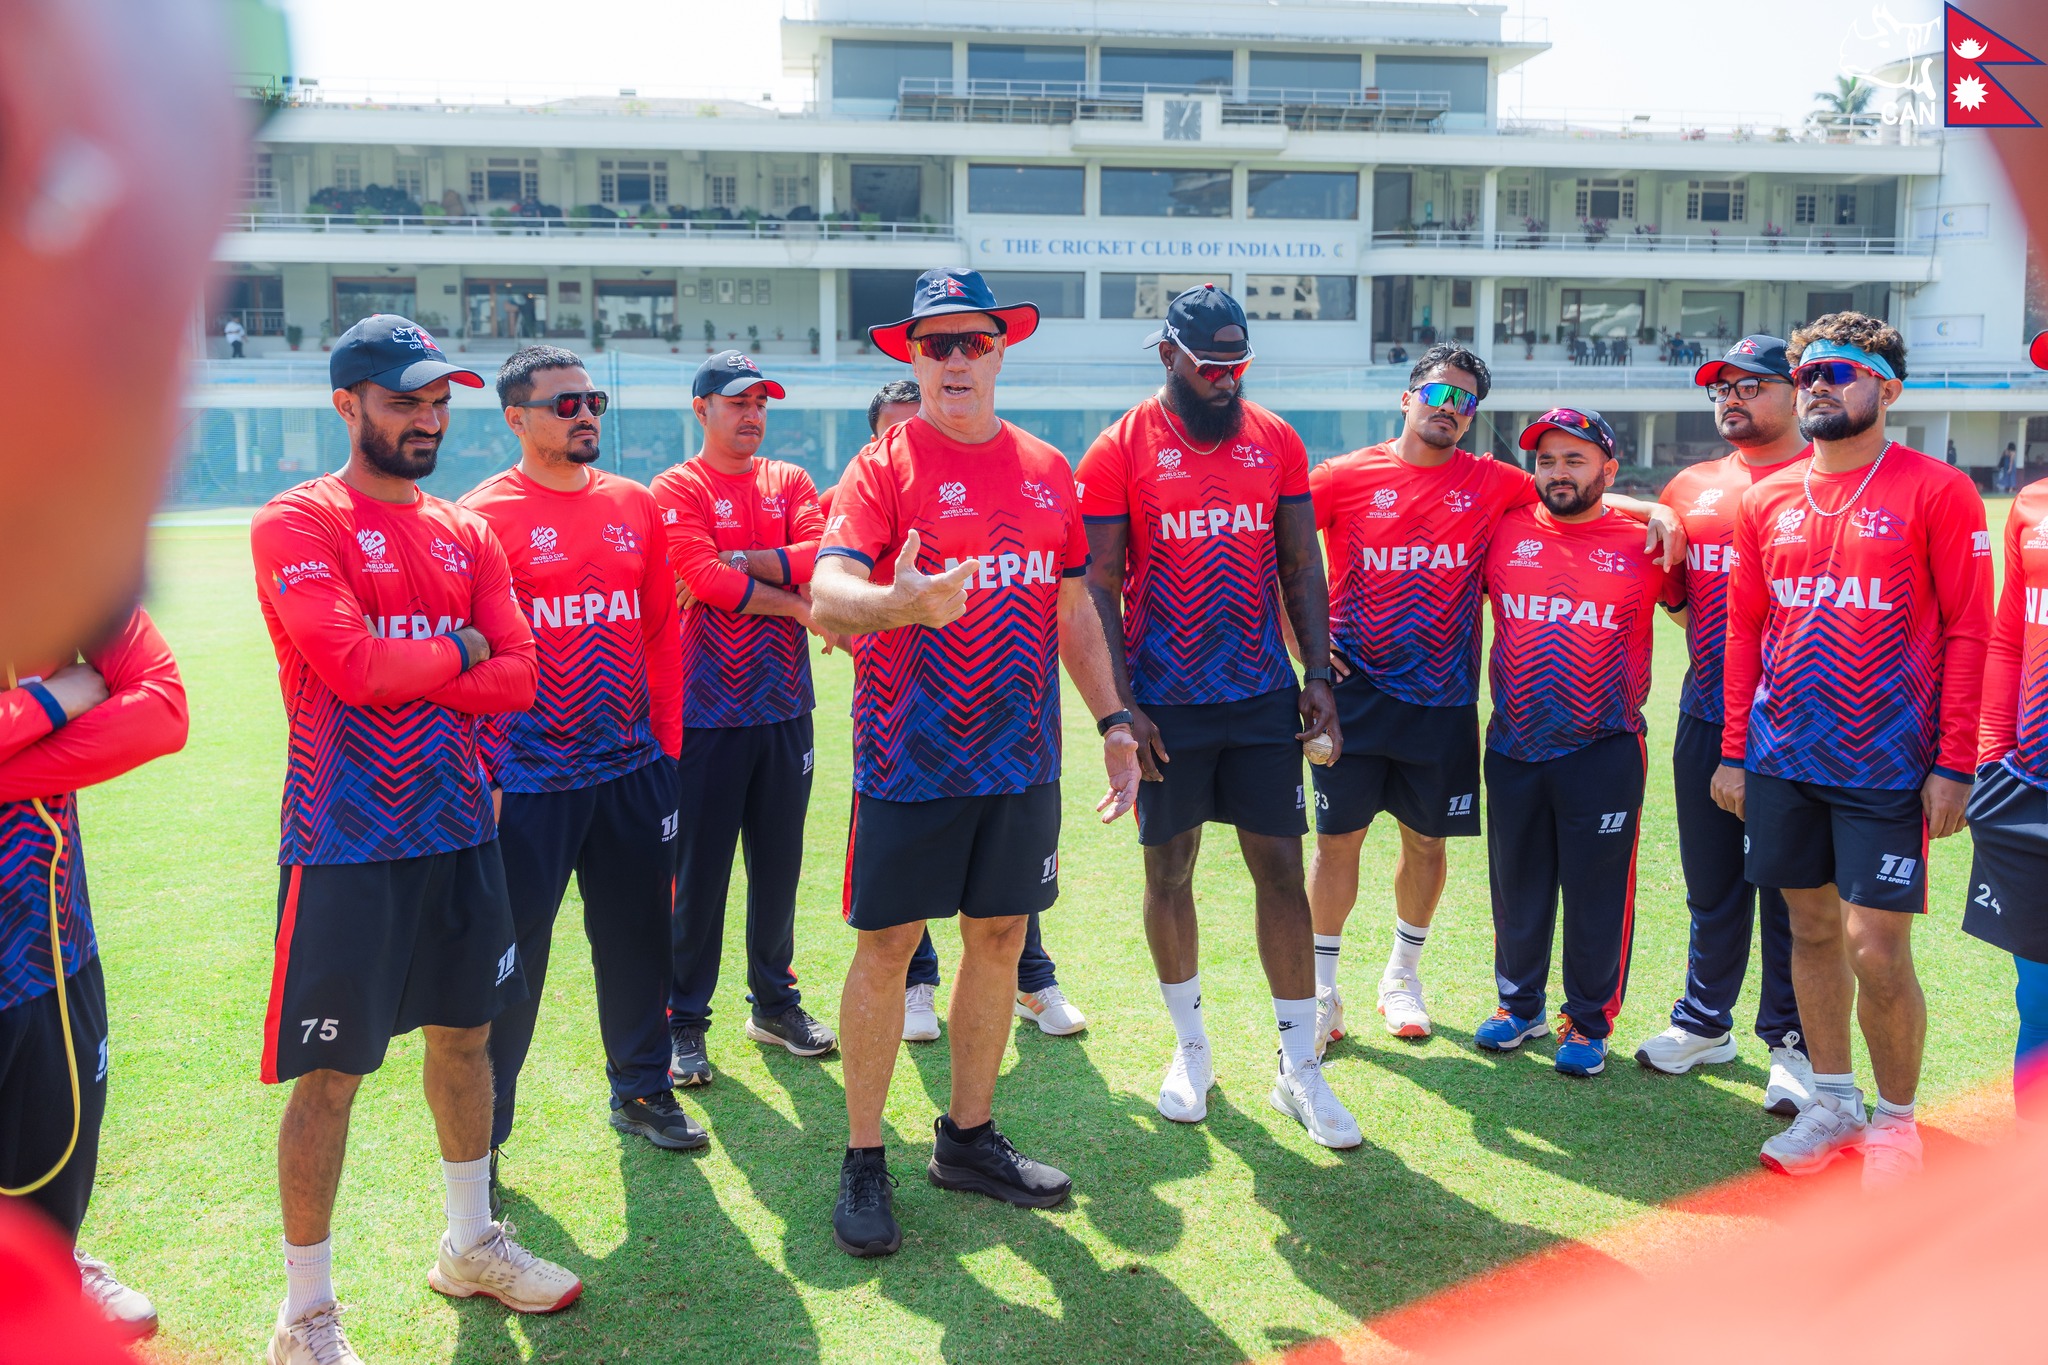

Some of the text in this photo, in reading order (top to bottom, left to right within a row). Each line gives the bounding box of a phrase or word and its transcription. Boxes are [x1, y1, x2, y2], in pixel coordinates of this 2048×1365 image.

[1003, 238, 1326, 258] THE CRICKET CLUB OF INDIA LTD.
[1034, 501, 1047, 509] CAN
[942, 508, 963, 516] WORLD
[1160, 502, 1270, 541] NEPAL
[1858, 530, 1874, 538] CAN
[532, 554, 554, 562] WORLD
[1362, 543, 1469, 571] NEPAL
[281, 561, 329, 577] NAASA
[444, 563, 458, 573] CAN
[1597, 565, 1612, 573] CAN
[1771, 575, 1893, 611] NEPAL
[1501, 593, 1620, 631] NEPAL
[1888, 876, 1911, 886] SPORTS
[301, 1017, 340, 1044] 75
